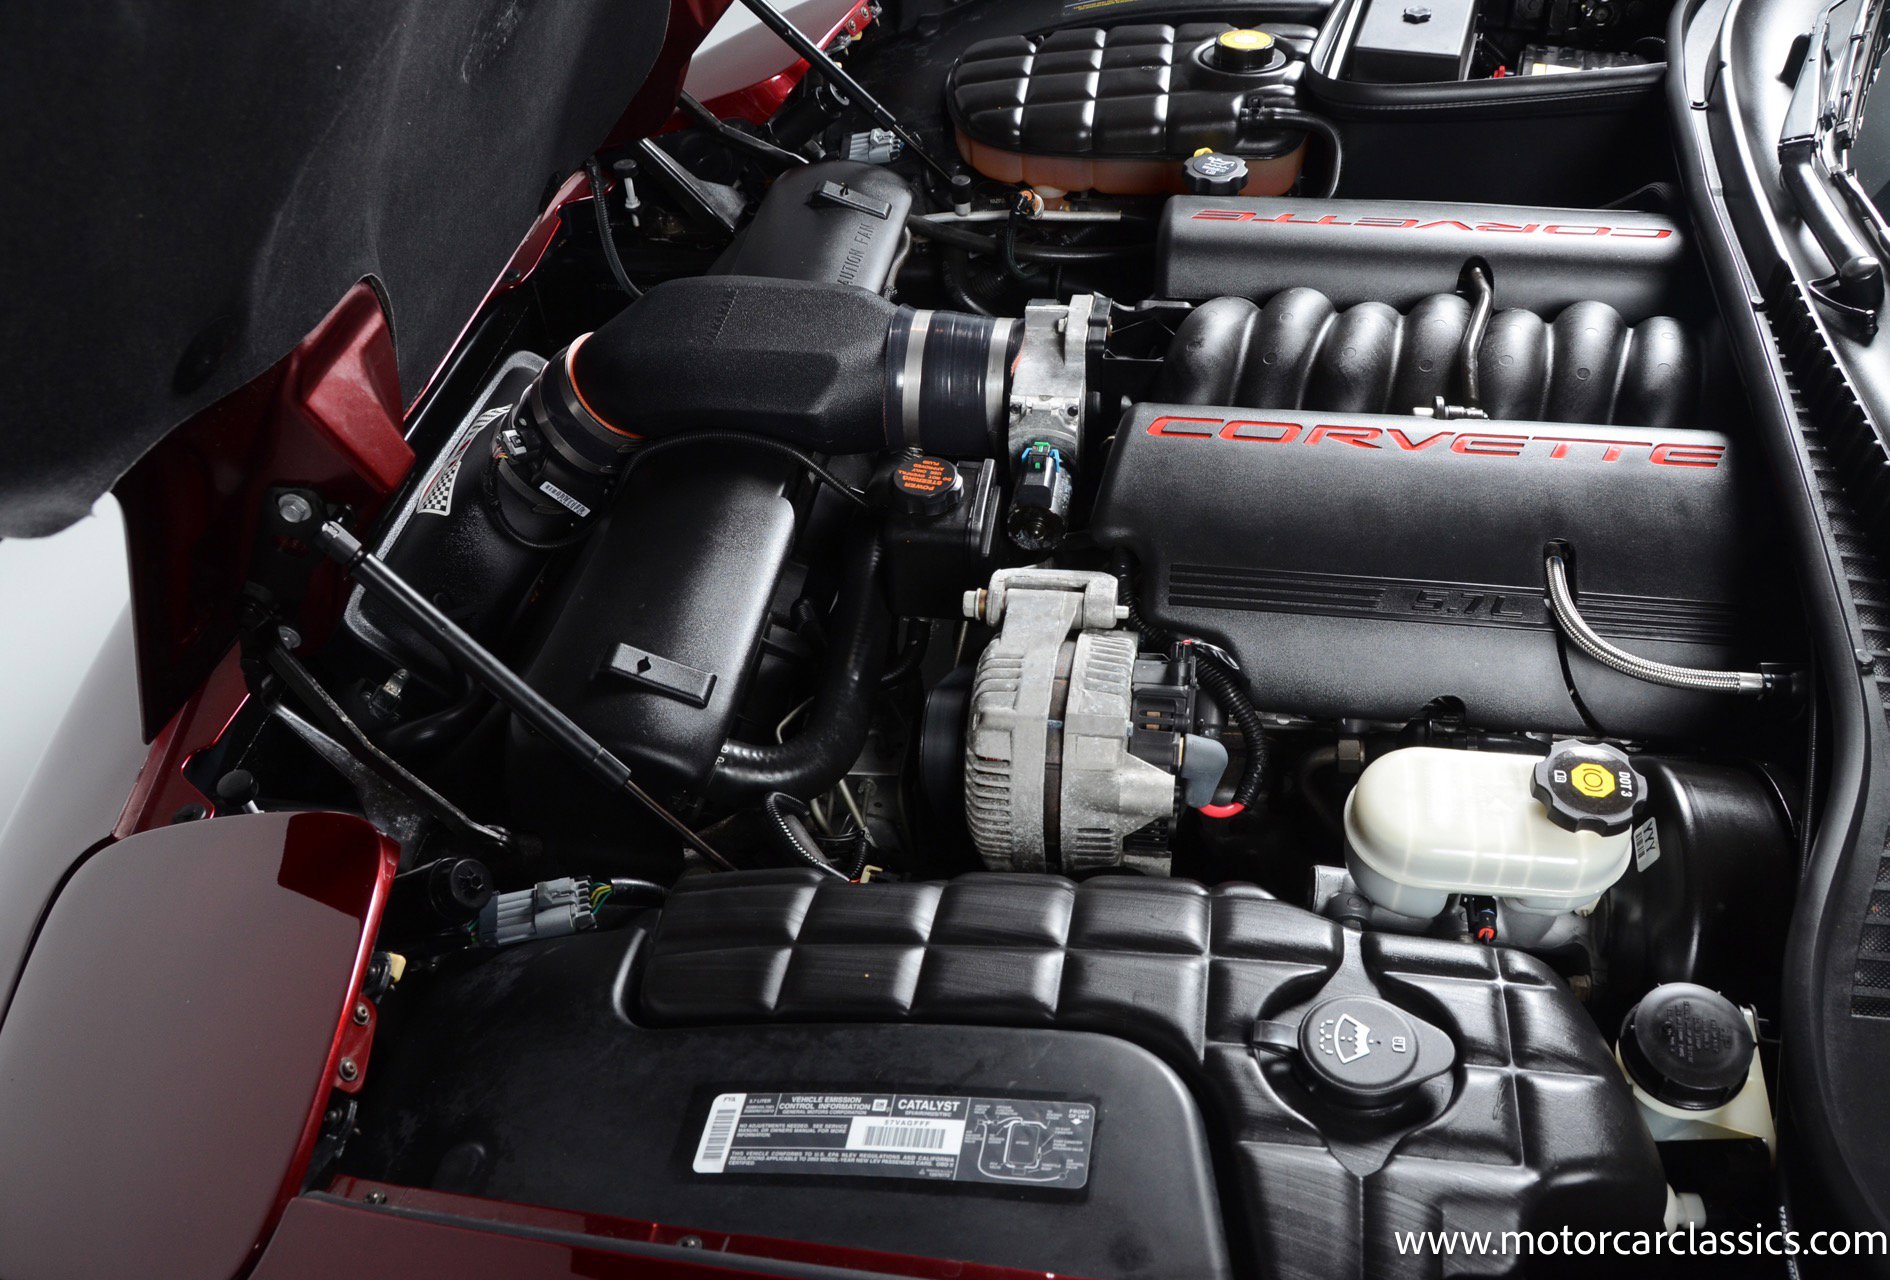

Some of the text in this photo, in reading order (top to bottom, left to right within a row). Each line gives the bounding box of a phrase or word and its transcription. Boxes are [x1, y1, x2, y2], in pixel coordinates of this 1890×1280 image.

[1192, 209, 1673, 239] CORVETTE
[837, 223, 874, 285] AUTION FAN
[1146, 415, 1726, 469] CORVETTE
[902, 475, 942, 486] STEERING
[904, 482, 936, 490] POWER
[1412, 590, 1523, 618] 5.7L
[1619, 771, 1632, 790] DOT
[1643, 821, 1656, 852] YYY
[898, 1099, 960, 1111] CATALYST
